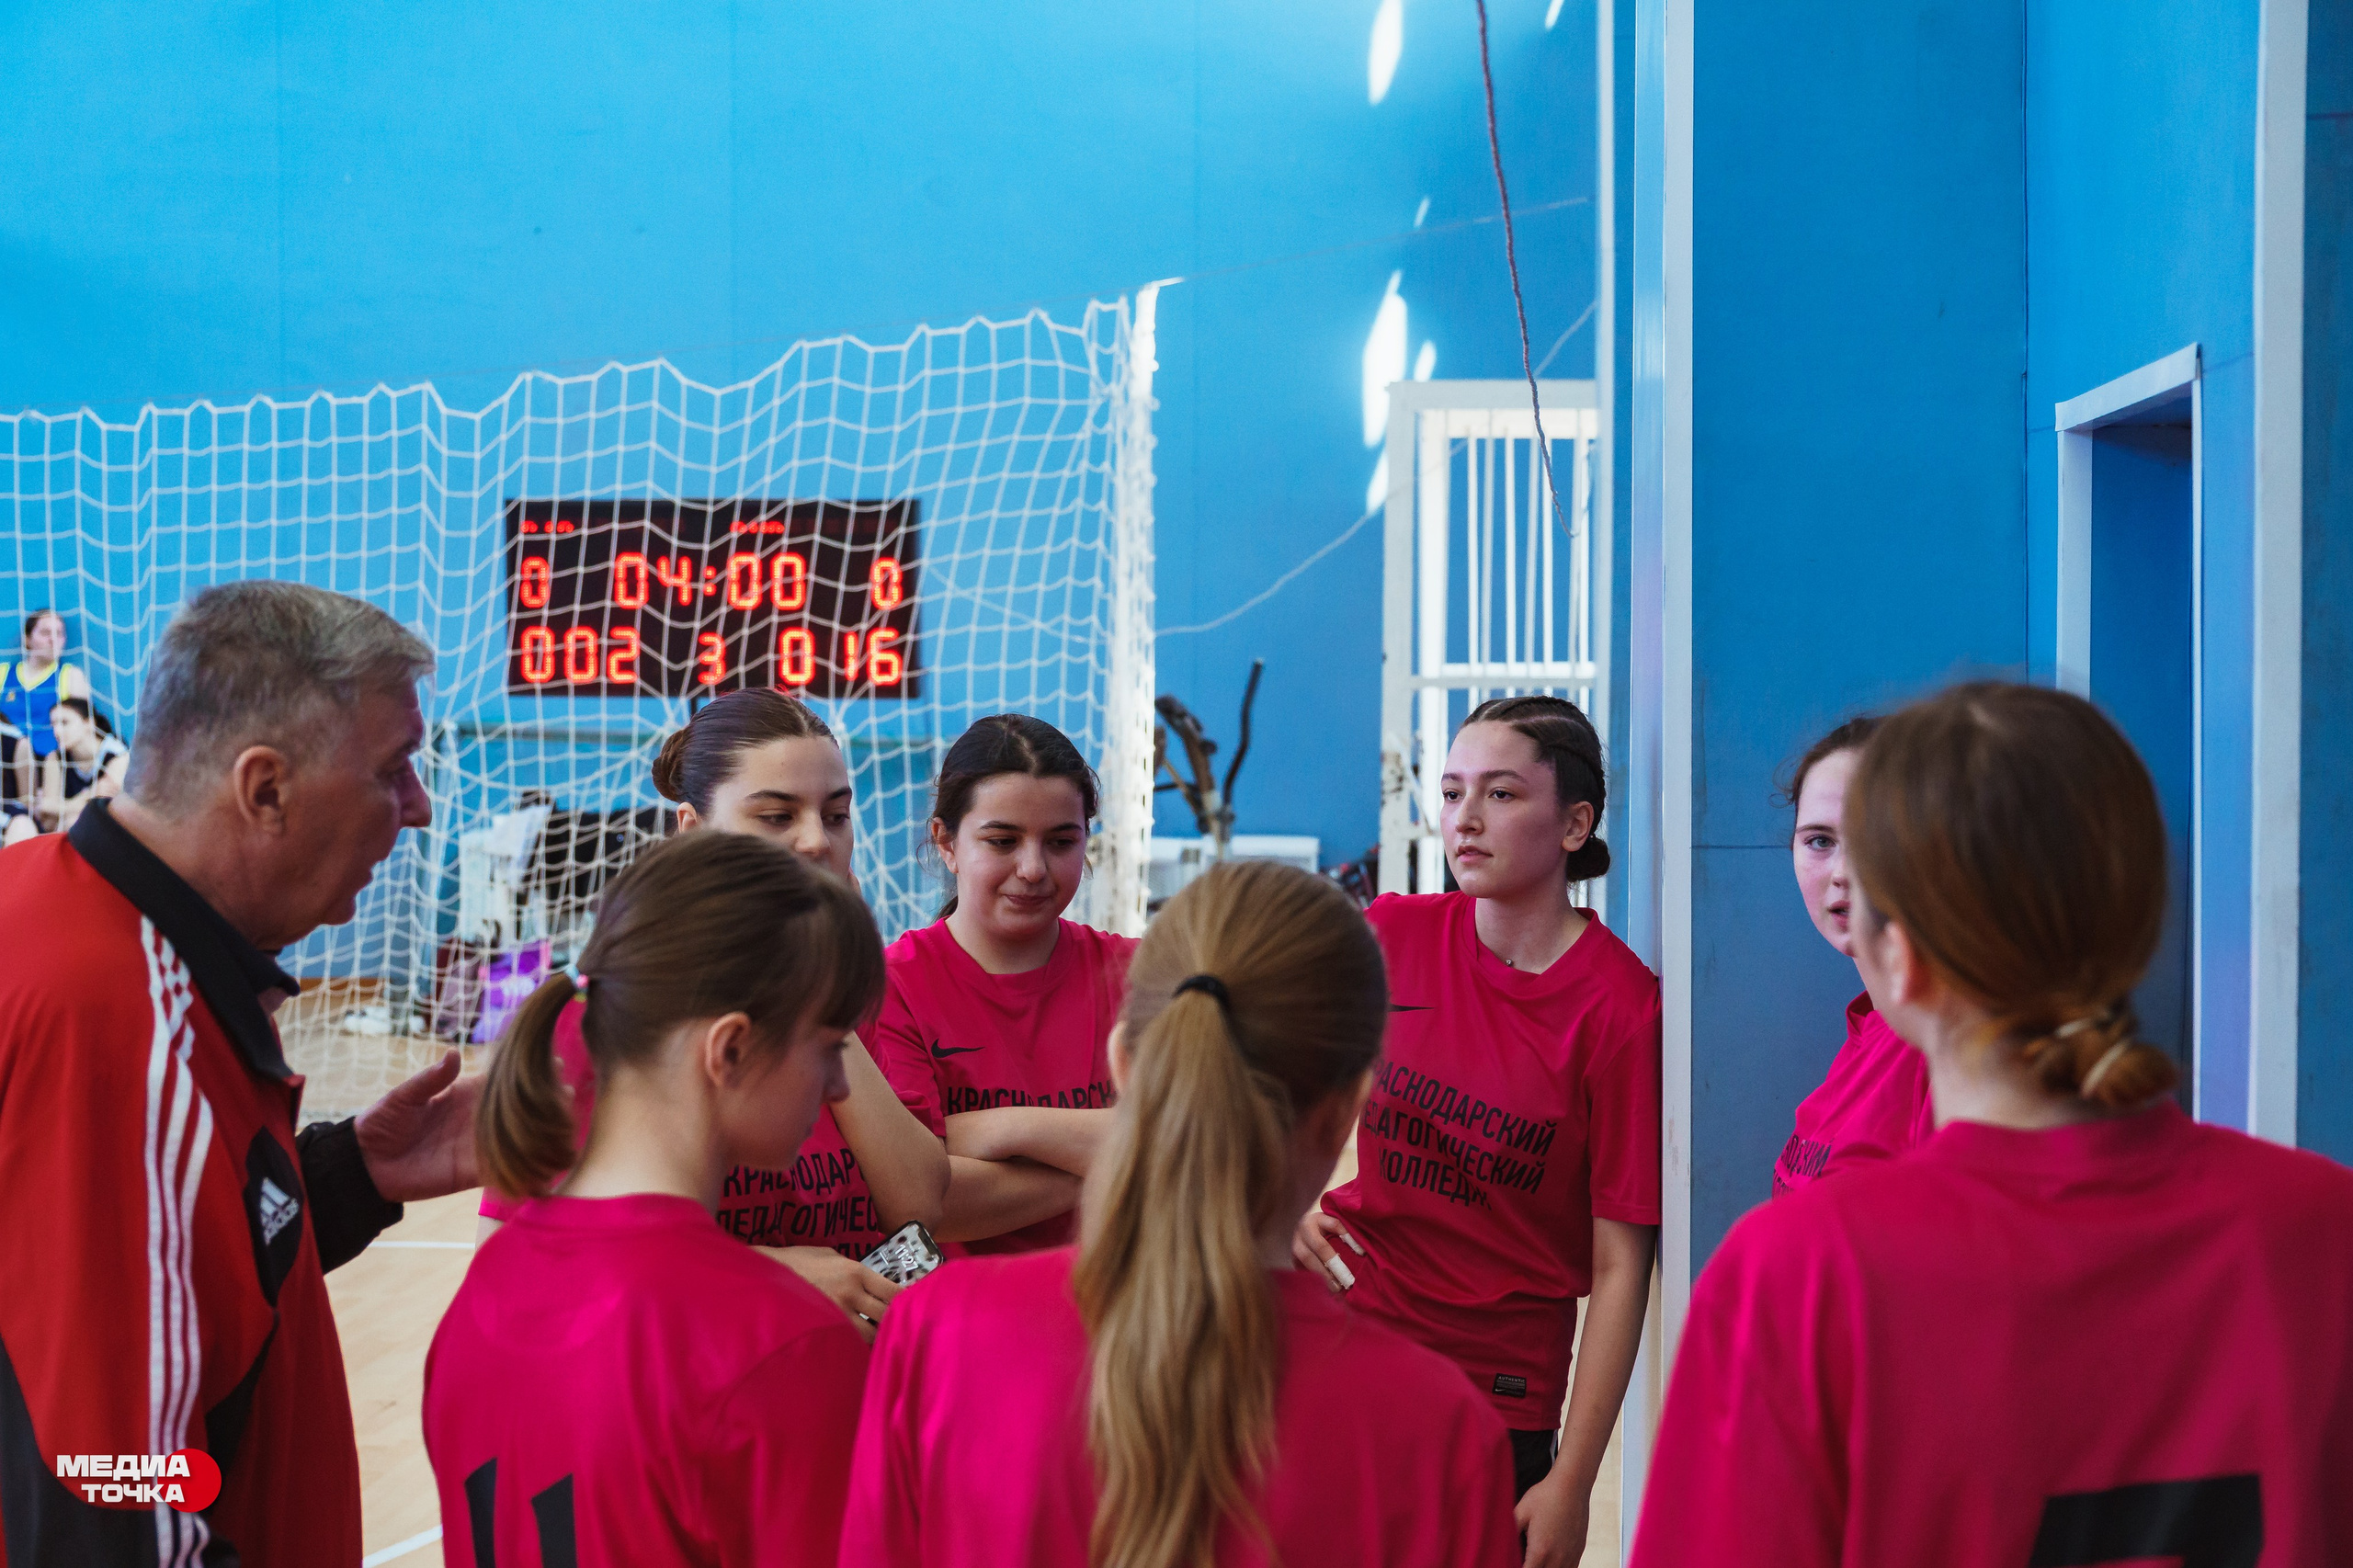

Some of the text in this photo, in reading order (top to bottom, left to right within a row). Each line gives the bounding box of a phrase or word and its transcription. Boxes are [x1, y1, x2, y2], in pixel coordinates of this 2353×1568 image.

[520, 555, 551, 608] 0
[614, 551, 806, 610] 04:00
[870, 557, 904, 610] 0
[520, 626, 641, 684] 002
[698, 631, 726, 686] 3
[894, 1244, 919, 1272] 11:27
